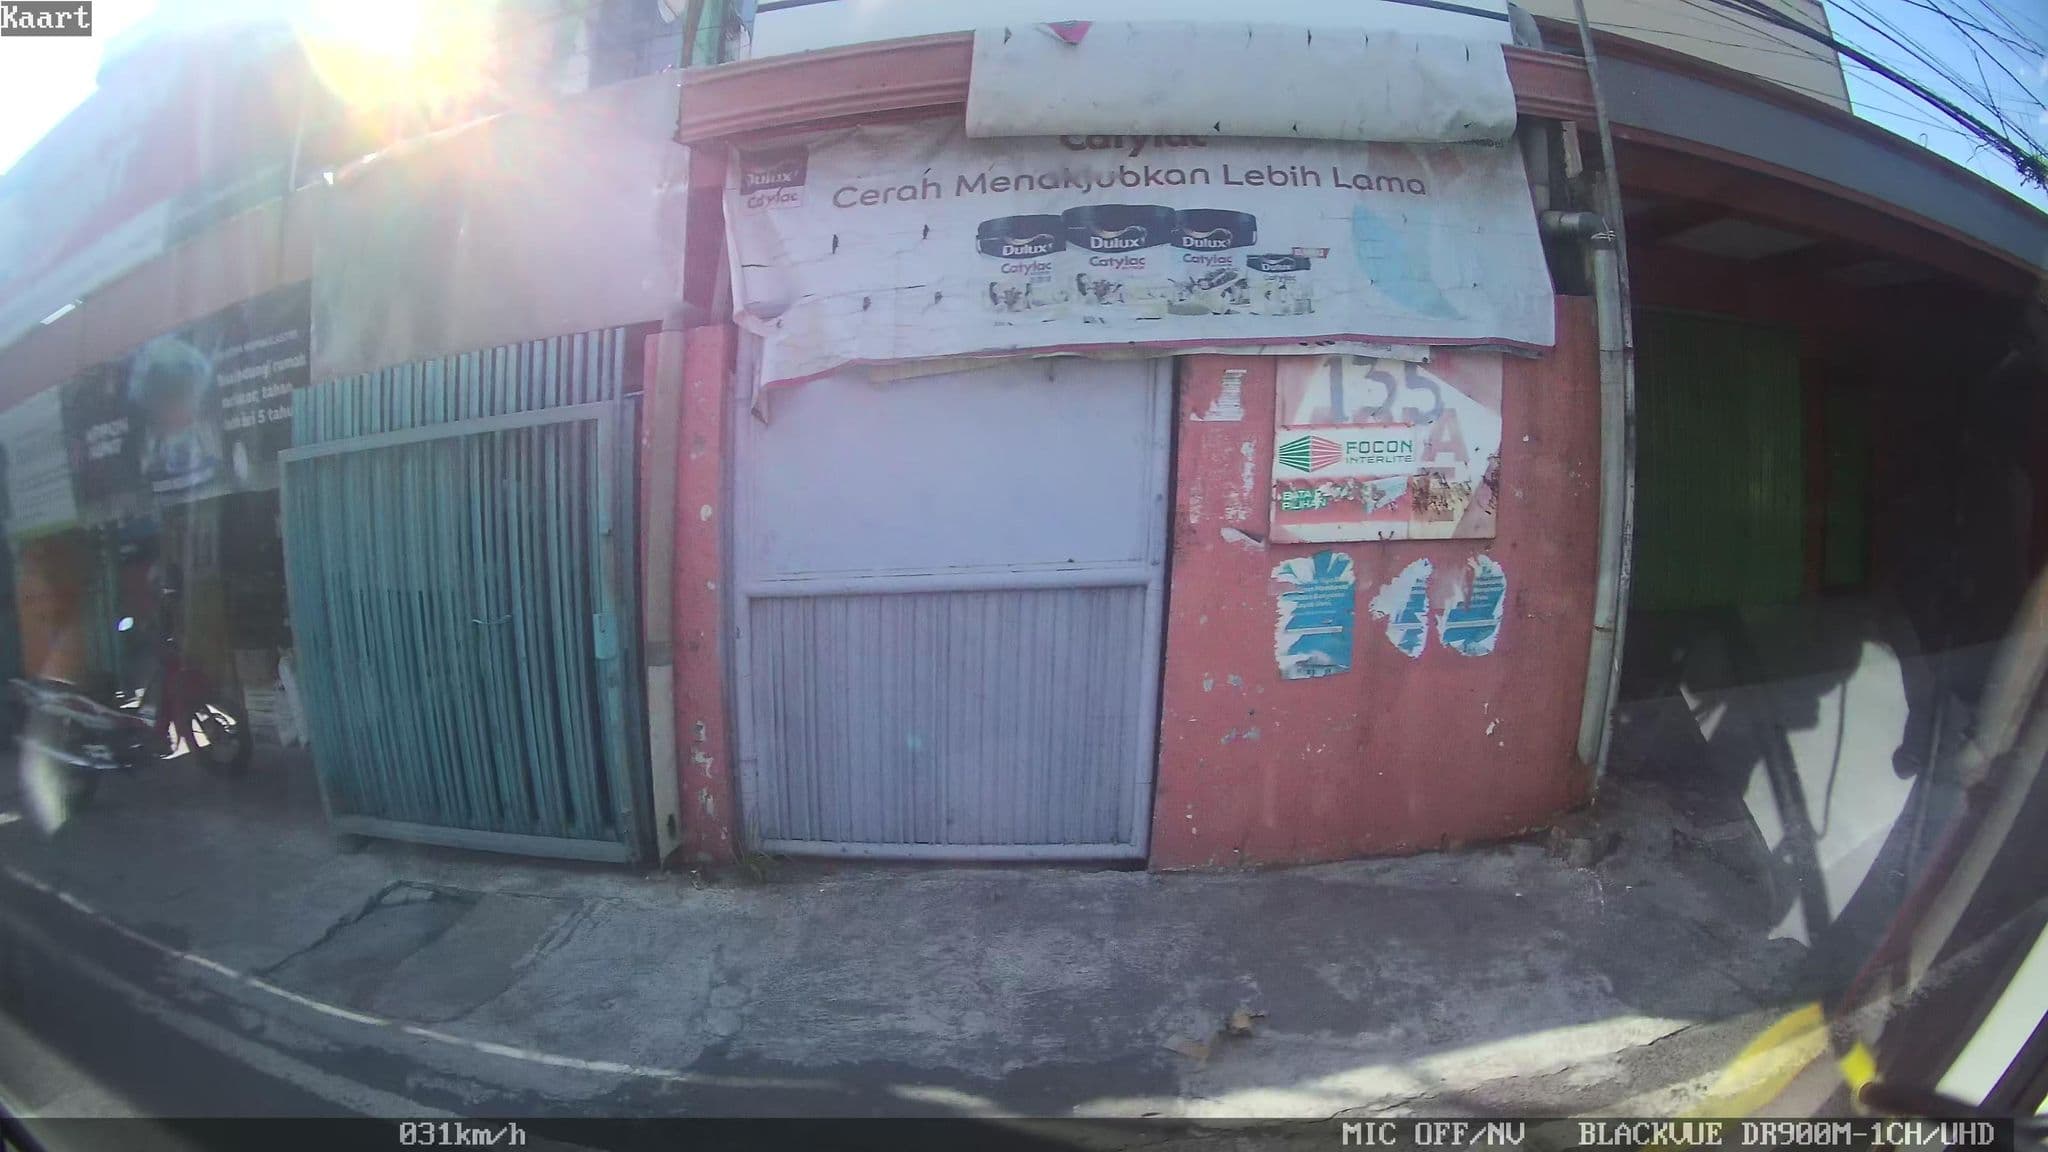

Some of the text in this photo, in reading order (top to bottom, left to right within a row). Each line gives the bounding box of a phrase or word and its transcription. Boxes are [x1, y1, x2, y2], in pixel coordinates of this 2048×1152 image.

[832, 163, 1427, 209] Cerah Menakjubkan Lebih Lama
[1089, 236, 1140, 250] Dulux
[1181, 236, 1227, 249] Dulux
[1002, 244, 1049, 257] Dulux
[1088, 254, 1146, 270] Catylac
[1182, 253, 1233, 267] Catylac
[1000, 261, 1052, 276] Catylac
[1323, 356, 1442, 424] 135
[1345, 440, 1413, 454] FOCON
[1345, 455, 1413, 465] INTERLITE
